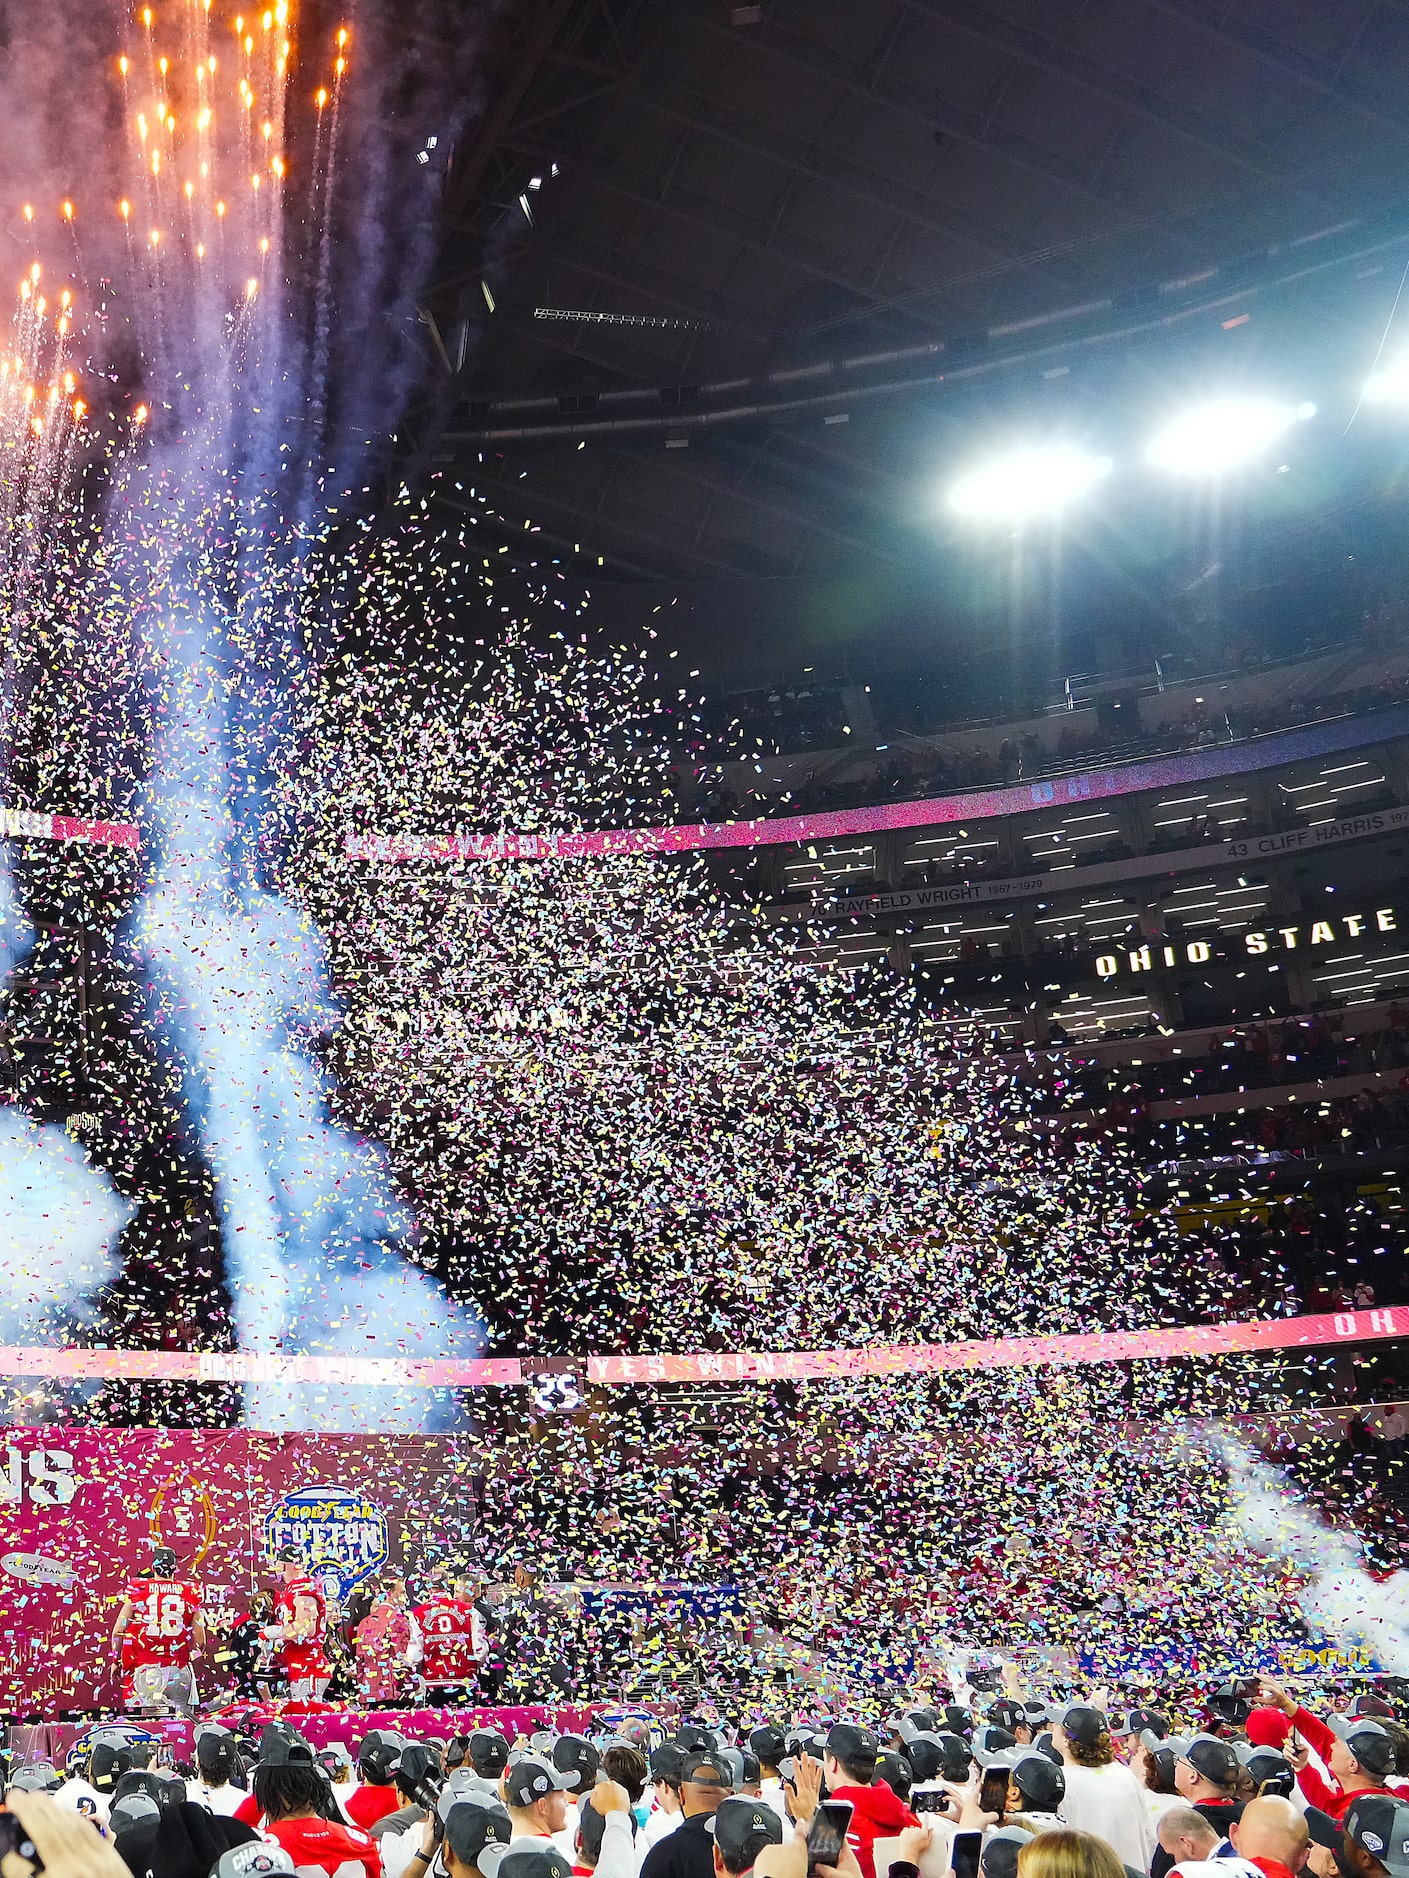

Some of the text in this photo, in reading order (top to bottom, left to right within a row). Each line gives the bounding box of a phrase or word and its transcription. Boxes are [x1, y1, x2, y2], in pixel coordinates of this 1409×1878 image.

[1227, 844, 1249, 858] 43
[1259, 831, 1309, 853] CLIFF
[1315, 816, 1385, 841] HARRIS
[835, 894, 912, 915] RAYFIELD
[917, 886, 983, 904] WRIGHT
[987, 879, 1044, 896] 1967-1979
[1095, 908, 1397, 978] OHIO STATE
[13, 1560, 62, 1576] GODYEAR
[148, 1583, 184, 1595] HOWARD
[145, 1593, 186, 1637] 18
